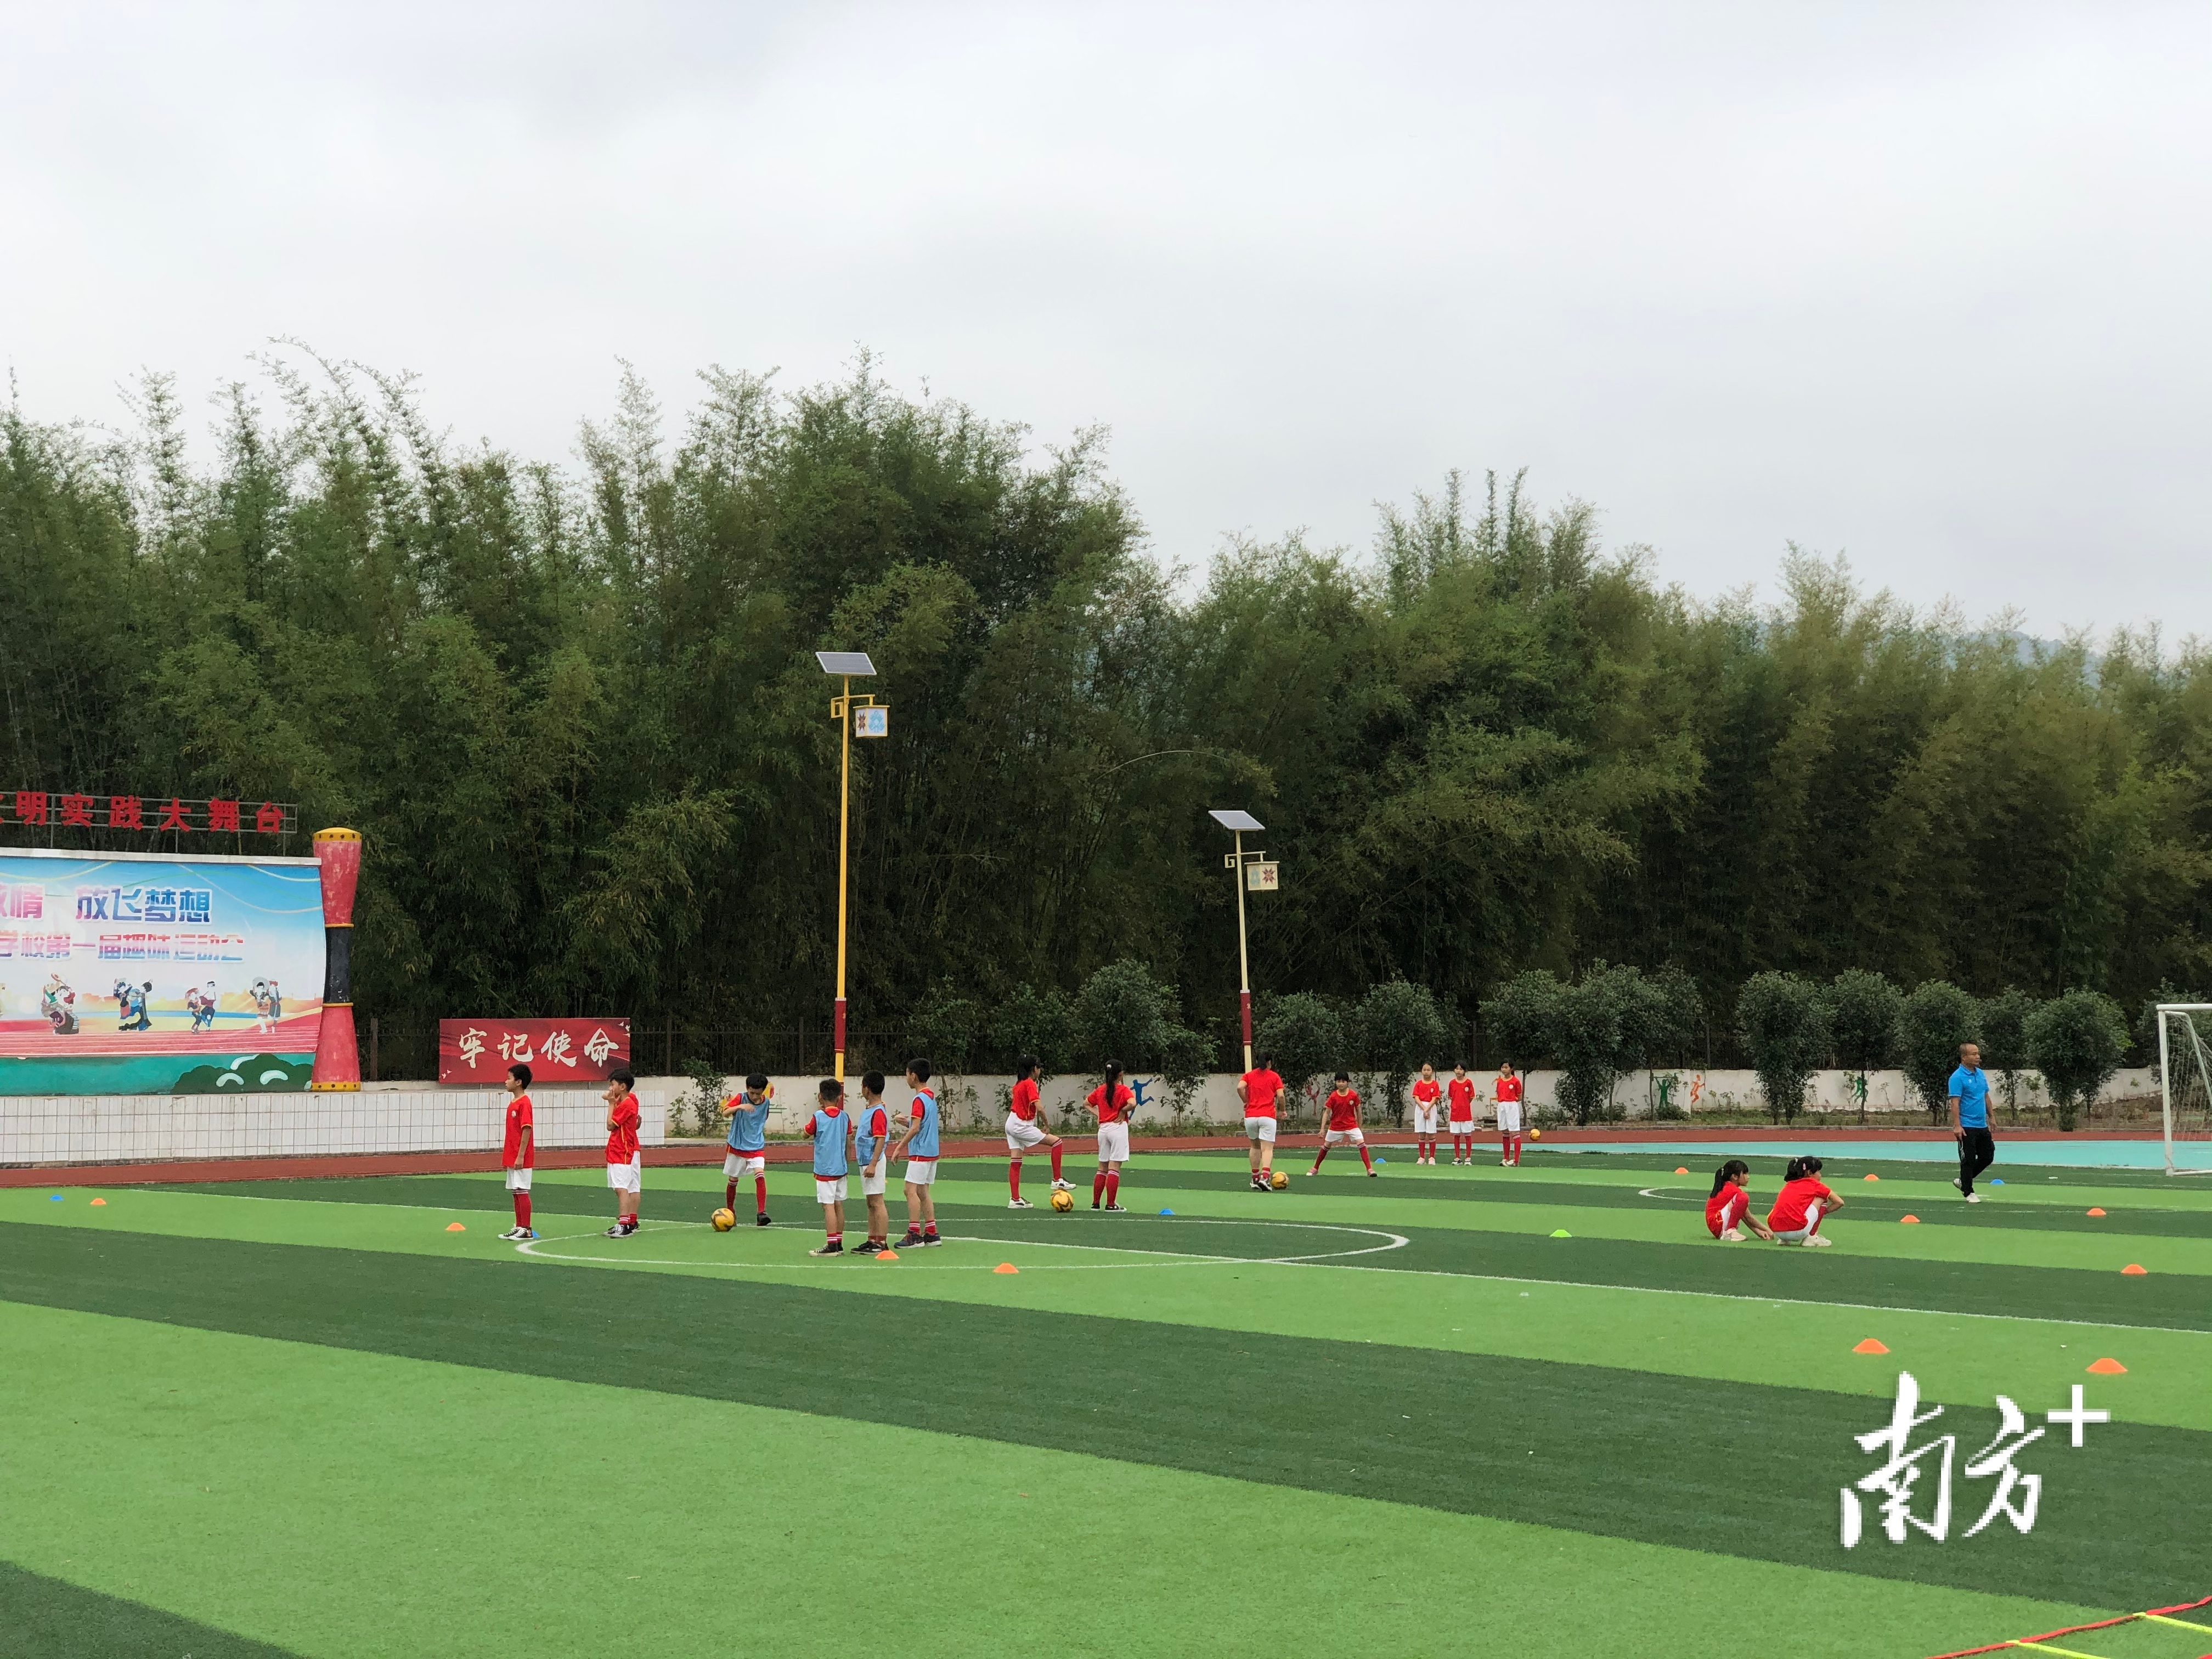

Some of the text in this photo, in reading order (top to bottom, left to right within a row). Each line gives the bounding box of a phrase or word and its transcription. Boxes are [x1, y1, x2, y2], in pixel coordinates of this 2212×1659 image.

[0, 791, 284, 833] 明实践大舞台
[75, 887, 210, 923] 放飞梦想
[459, 1027, 619, 1069] 牢记使命
